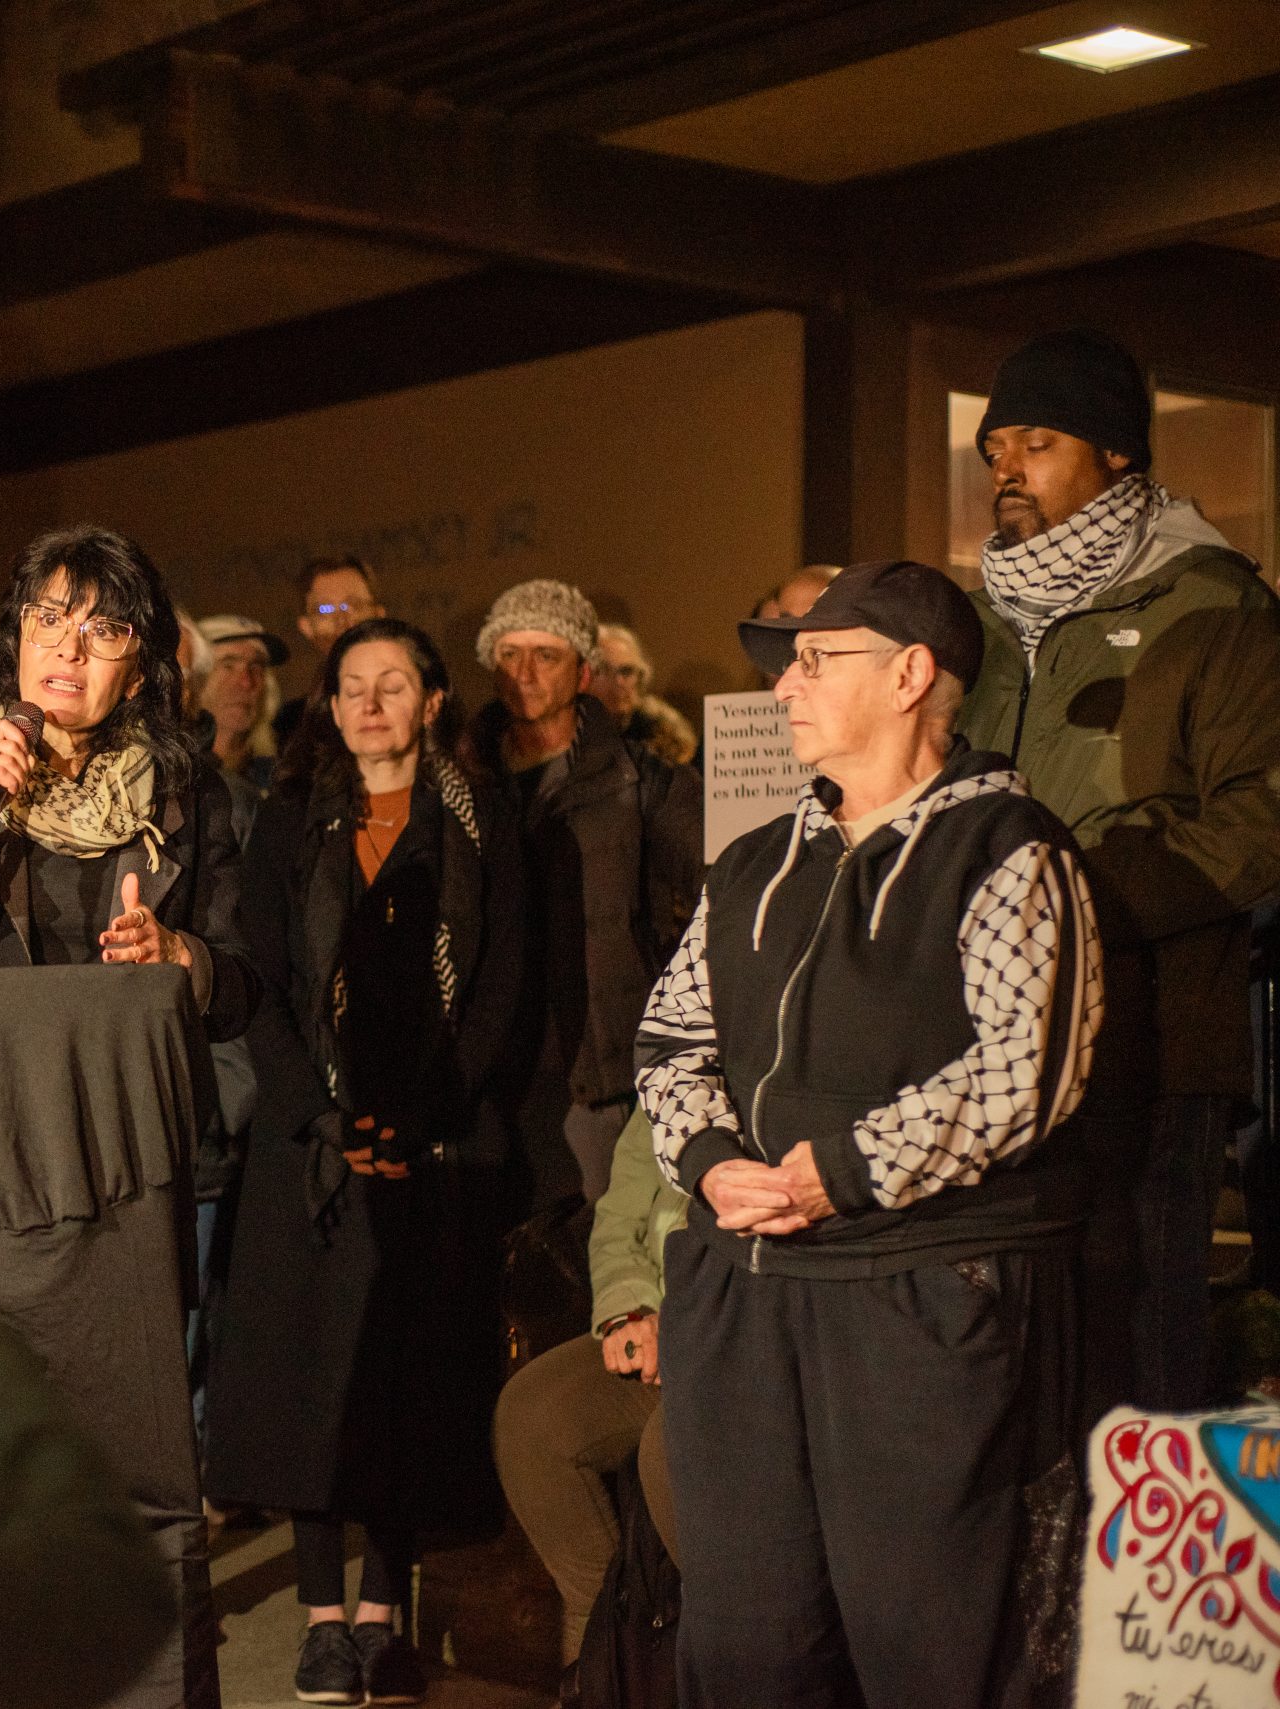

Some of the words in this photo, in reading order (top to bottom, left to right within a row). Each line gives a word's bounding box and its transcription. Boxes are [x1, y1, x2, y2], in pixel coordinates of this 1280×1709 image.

[714, 702, 789, 718] “Yesterda
[714, 722, 783, 740] bombed.
[714, 748, 726, 760] is
[732, 748, 756, 759] not
[714, 764, 776, 778] because
[782, 762, 791, 774] it
[713, 790, 729, 799] es
[735, 783, 759, 798] the
[766, 782, 798, 797] hear
[1115, 1592, 1161, 1660] tu
[1169, 1631, 1265, 1673] eres
